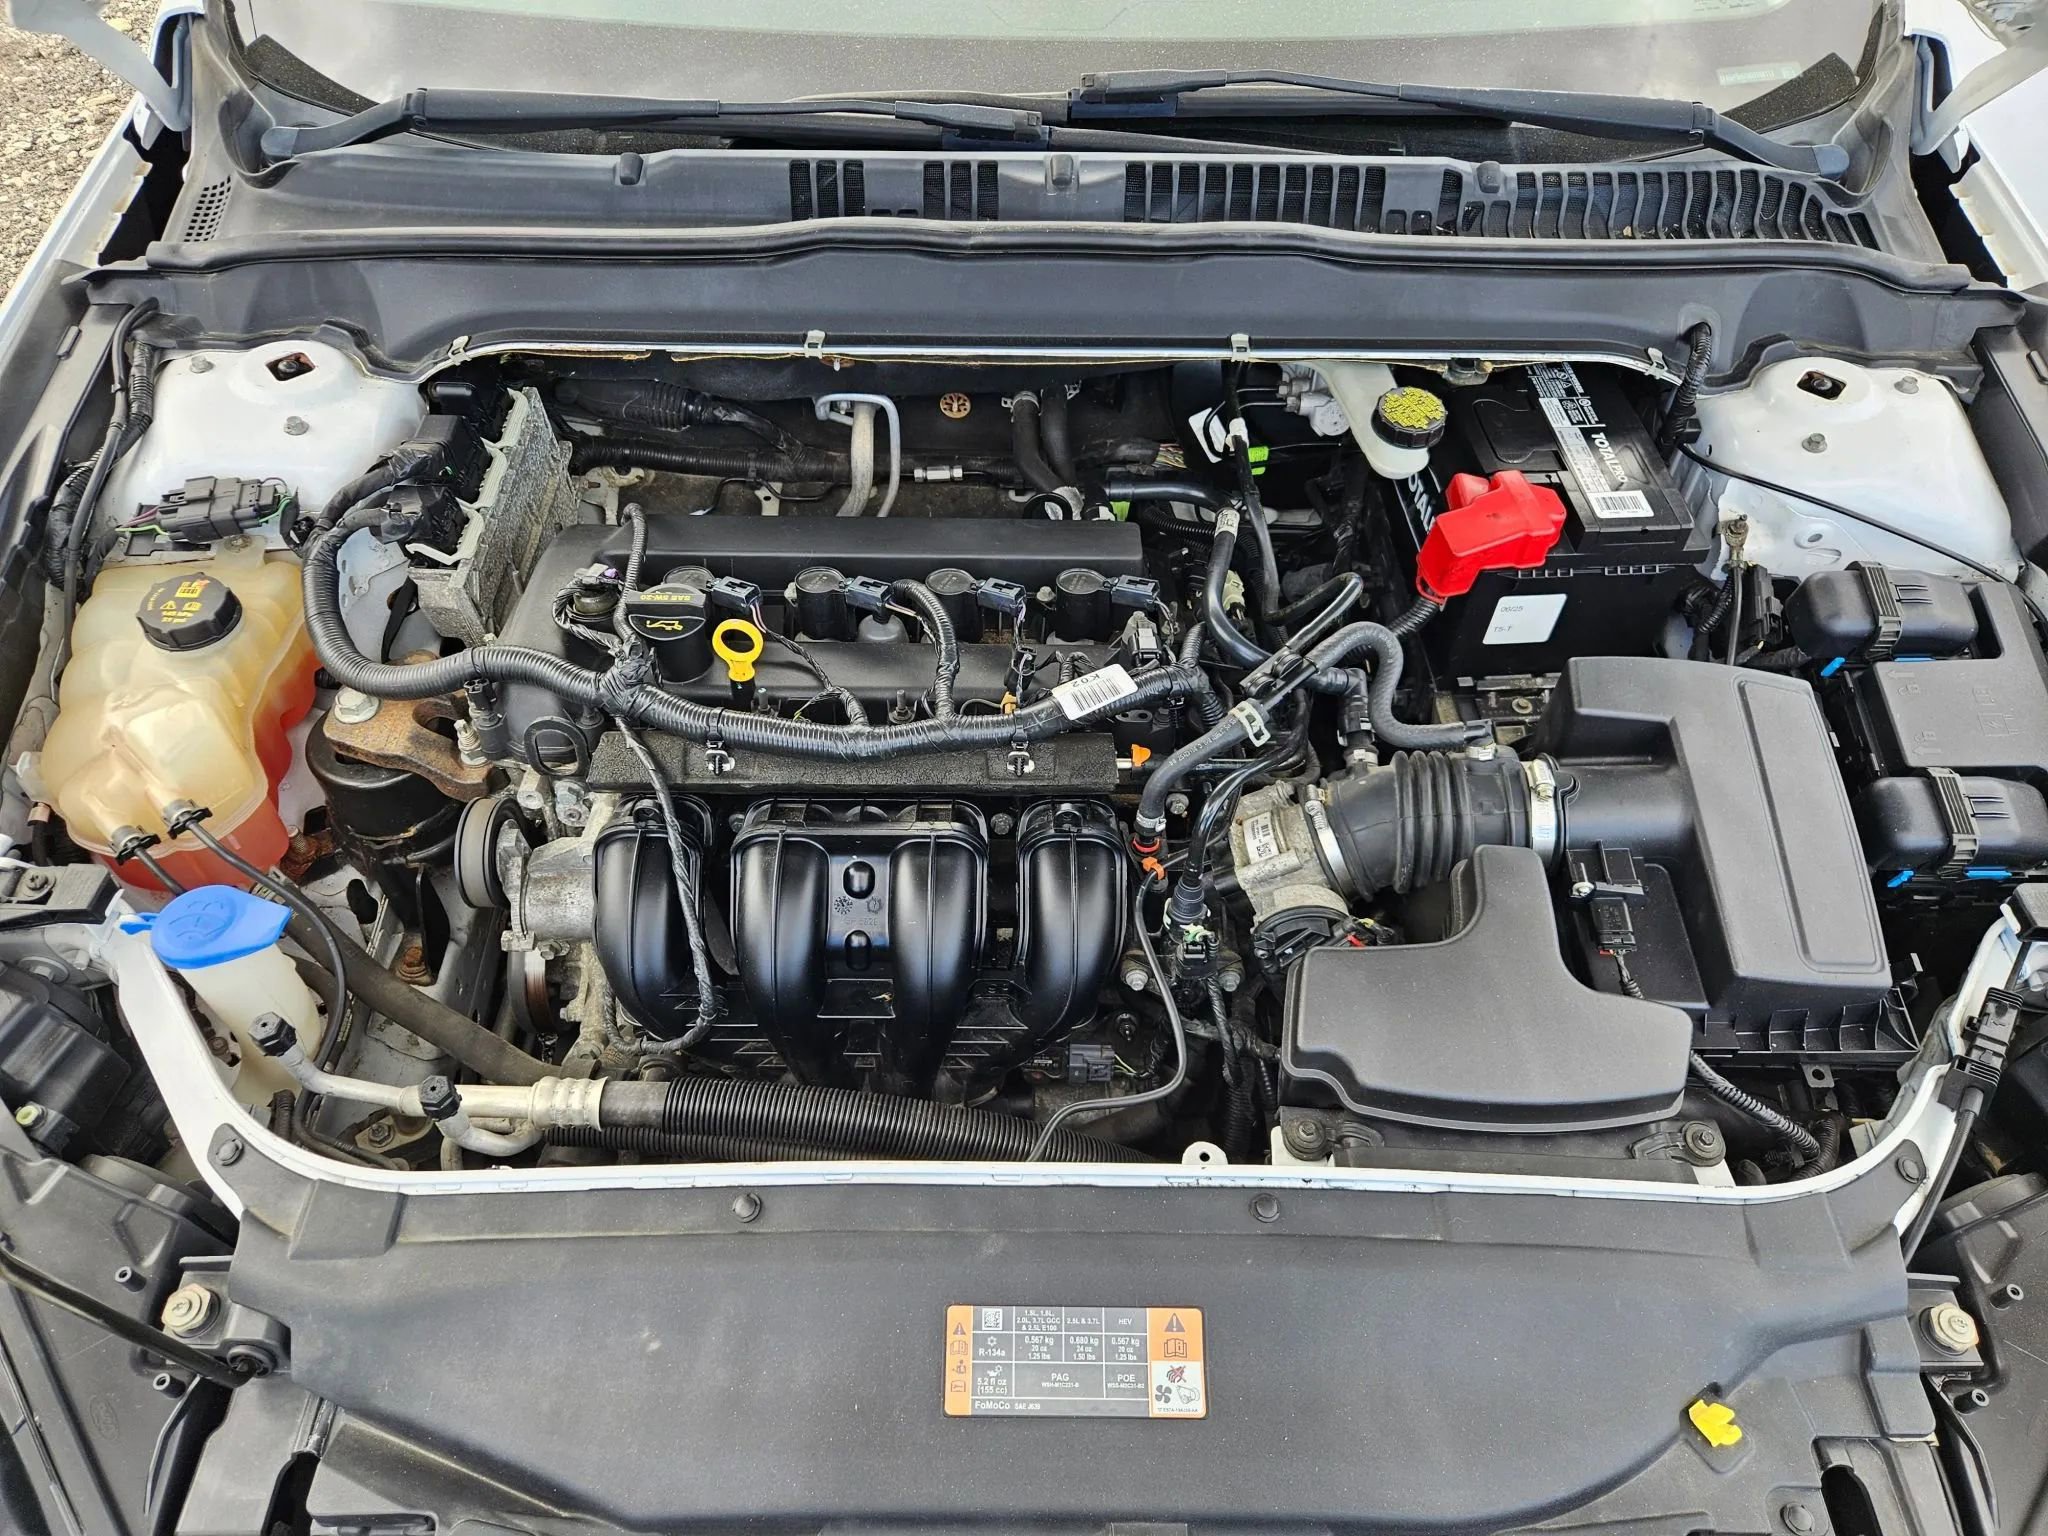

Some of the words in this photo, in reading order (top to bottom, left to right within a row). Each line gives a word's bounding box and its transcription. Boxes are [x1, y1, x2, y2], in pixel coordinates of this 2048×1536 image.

[1025, 1336, 1043, 1344] 0.567
[1045, 1336, 1054, 1345] kg
[1090, 1336, 1099, 1346] kg
[1111, 1337, 1129, 1345] 0.567
[1131, 1338, 1140, 1347] kg
[977, 1377, 989, 1385] 5.2
[1051, 1373, 1069, 1381] PAG
[1117, 1374, 1136, 1382] POE
[977, 1386, 994, 1395] (155
[995, 1386, 1008, 1395] cc)
[975, 1400, 1010, 1409] FoMoCo
[1014, 1402, 1027, 1410] SAE
